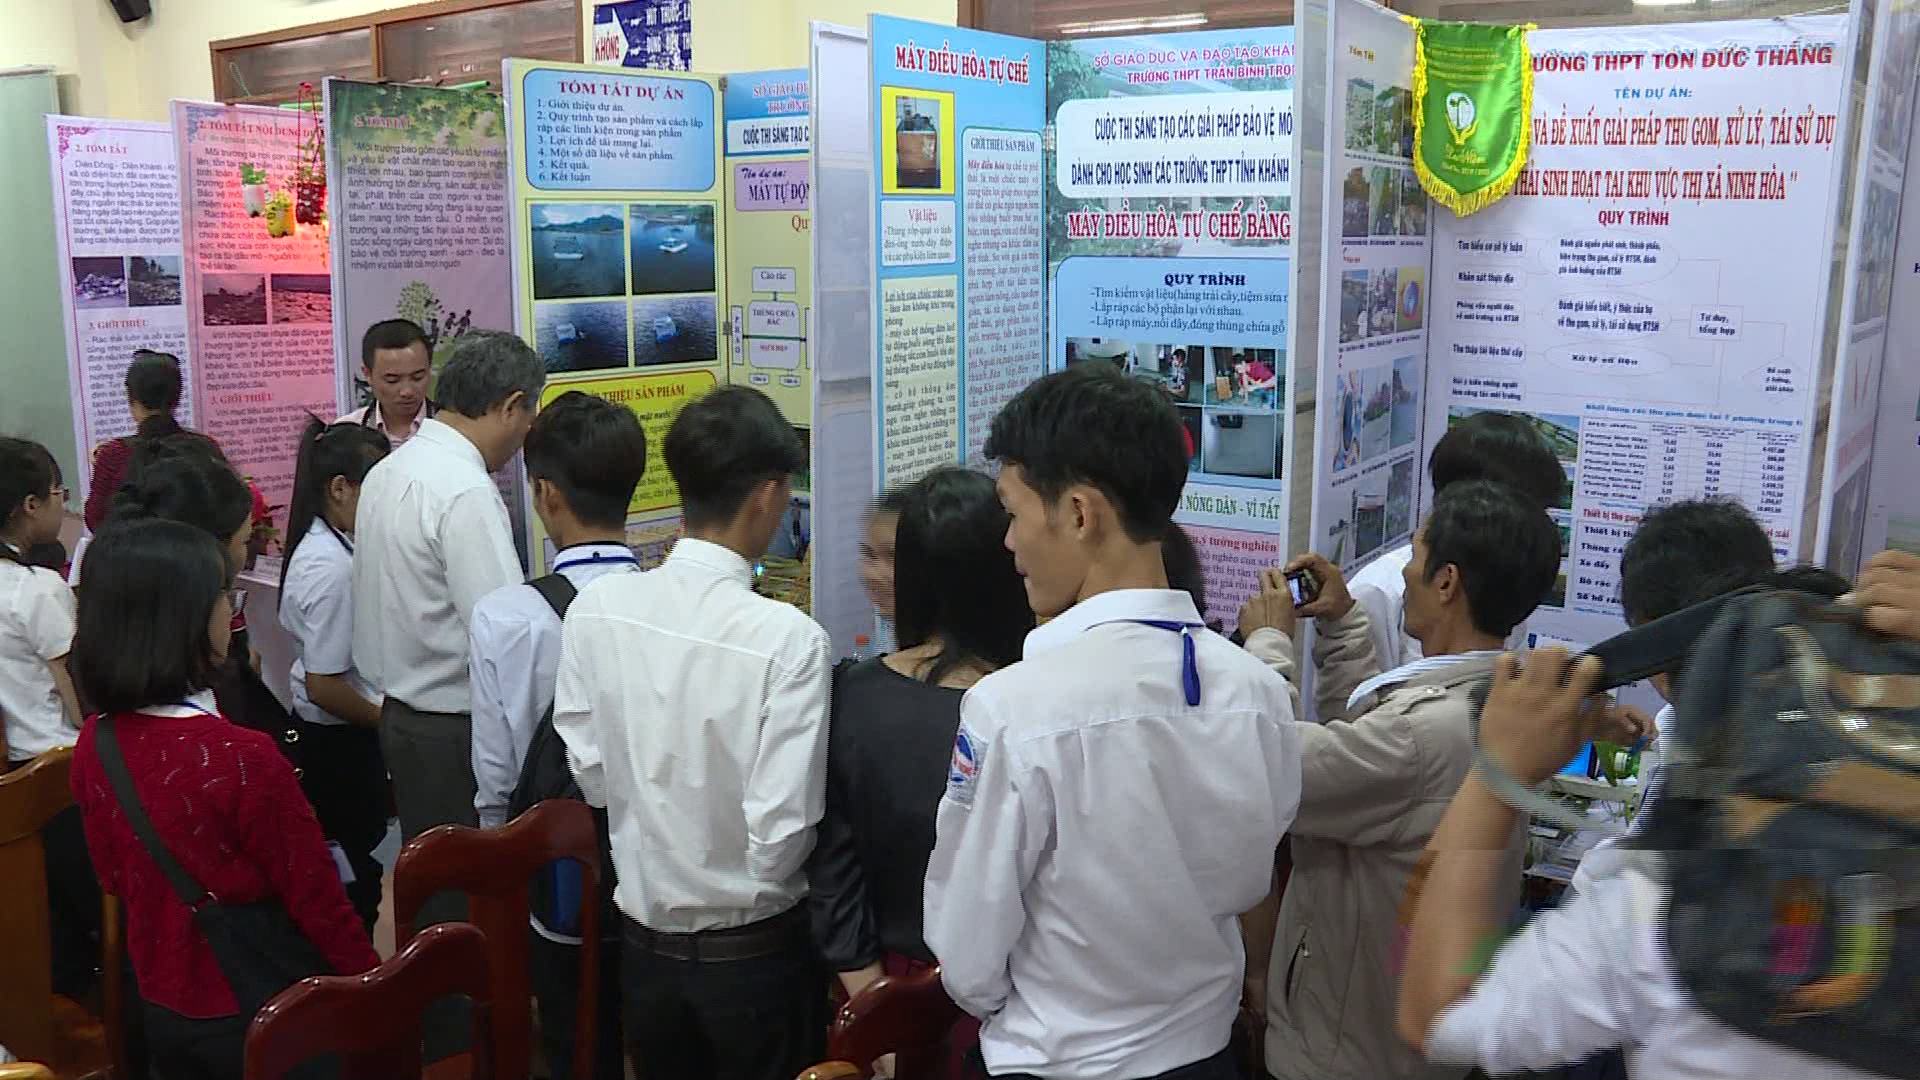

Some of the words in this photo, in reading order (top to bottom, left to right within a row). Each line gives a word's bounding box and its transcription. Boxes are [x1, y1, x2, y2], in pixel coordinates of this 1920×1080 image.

[595, 32, 619, 60] KHÔNG
[1095, 54, 1110, 67] SỞ
[1114, 51, 1145, 65] GIÁO
[1203, 46, 1231, 60] ĐÀO
[1235, 46, 1260, 59] TẠO
[1533, 51, 1585, 72] ƯỜNG
[1592, 54, 1645, 71] THPT
[1702, 46, 1749, 68] ĐỨC
[1755, 40, 1832, 66] THẮNG
[896, 42, 925, 69] MÁY
[929, 41, 959, 74] ĐIỀU
[962, 51, 986, 78] HÒA
[989, 57, 1005, 84] TỰ
[1008, 54, 1029, 83] CHẾ
[1127, 68, 1170, 84] TRƯỜNG
[1173, 68, 1200, 81] THPT
[1205, 65, 1234, 80] TRẦN
[1238, 64, 1264, 78] BÌNH
[559, 80, 597, 94] TÓM
[637, 85, 660, 101] DỰ
[663, 83, 684, 100] ÁN
[1615, 85, 1640, 98] TÊN
[1645, 88, 1664, 100] DỰ
[1669, 86, 1692, 99] ÁN:
[537, 99, 545, 107] 1.
[548, 99, 570, 109] Giới
[573, 101, 595, 111] thiệu
[598, 103, 610, 112] dự
[537, 111, 545, 120] 2.
[548, 112, 569, 122] Quy
[572, 113, 593, 121] trình
[597, 114, 610, 123] tạo
[629, 114, 654, 126] phẩm
[669, 116, 688, 126] cách
[1095, 112, 1116, 145] CUỘC
[1119, 117, 1132, 139] THI
[1135, 114, 1156, 139] SÁNG
[1159, 115, 1176, 144] TẠO
[1178, 111, 1195, 138] CÁC
[1197, 105, 1215, 137] GIẢI
[1217, 108, 1240, 136] PHÁP
[1243, 105, 1261, 136] BẢO
[1264, 106, 1275, 141] VỆ
[1534, 112, 1547, 145] VÀ
[1551, 102, 1566, 145] ĐỀ
[1569, 104, 1600, 145] XUẤT
[1603, 108, 1628, 145] GIẢI
[1630, 109, 1661, 145] PHÁP
[1665, 117, 1689, 145] THU
[1692, 117, 1721, 149] GOM,
[1725, 106, 1744, 145] XỬ
[1746, 108, 1765, 149] LÝ,
[1770, 107, 1792, 144] TÁI
[1795, 105, 1814, 145] SỬ
[761, 128, 771, 144] THI
[773, 123, 789, 143] SÁNG
[791, 127, 803, 146] TẠO
[550, 150, 569, 158] Một
[600, 150, 616, 160] liệu
[619, 150, 629, 159] về
[551, 160, 568, 169] Kết
[551, 172, 569, 181] Kết
[571, 173, 590, 183] luận
[1072, 157, 1094, 186] DÀNH
[1096, 163, 1112, 185] CHO
[1115, 163, 1131, 190] HỌC
[1133, 162, 1152, 184] SINH
[1155, 156, 1172, 184] CÁC
[1174, 154, 1208, 184] TRƯỜNG
[1210, 159, 1233, 183] THPT
[1236, 150, 1256, 183] TỈNH
[1259, 152, 1290, 182] KHÁNH
[749, 180, 772, 201] MÁY
[773, 181, 789, 204] TỰ
[1542, 170, 1568, 196] SINH
[1571, 170, 1602, 203] HOẠT
[1605, 171, 1624, 204] TẠI
[1627, 171, 1652, 198] KHU
[1655, 167, 1678, 205] VỰC
[1682, 171, 1702, 205] THỊ
[1726, 171, 1756, 199] NINH
[1758, 163, 1786, 200] HÒA
[1068, 205, 1100, 238] MÁY
[1105, 199, 1140, 238] ĐIỀU
[1146, 205, 1177, 238] HÒA
[1182, 210, 1204, 243] TỰ
[1208, 200, 1243, 238] CHẾ
[1247, 199, 1291, 238] BẰNG
[1598, 210, 1625, 227] QUY
[1628, 208, 1669, 225] TRÌNH
[1164, 273, 1194, 287] QUY
[1199, 271, 1246, 286] TRÌNH
[636, 387, 654, 400] SẢN
[657, 384, 685, 398] PHẨM
[1186, 493, 1213, 513] NÔNG
[1216, 495, 1237, 515] DÂN
